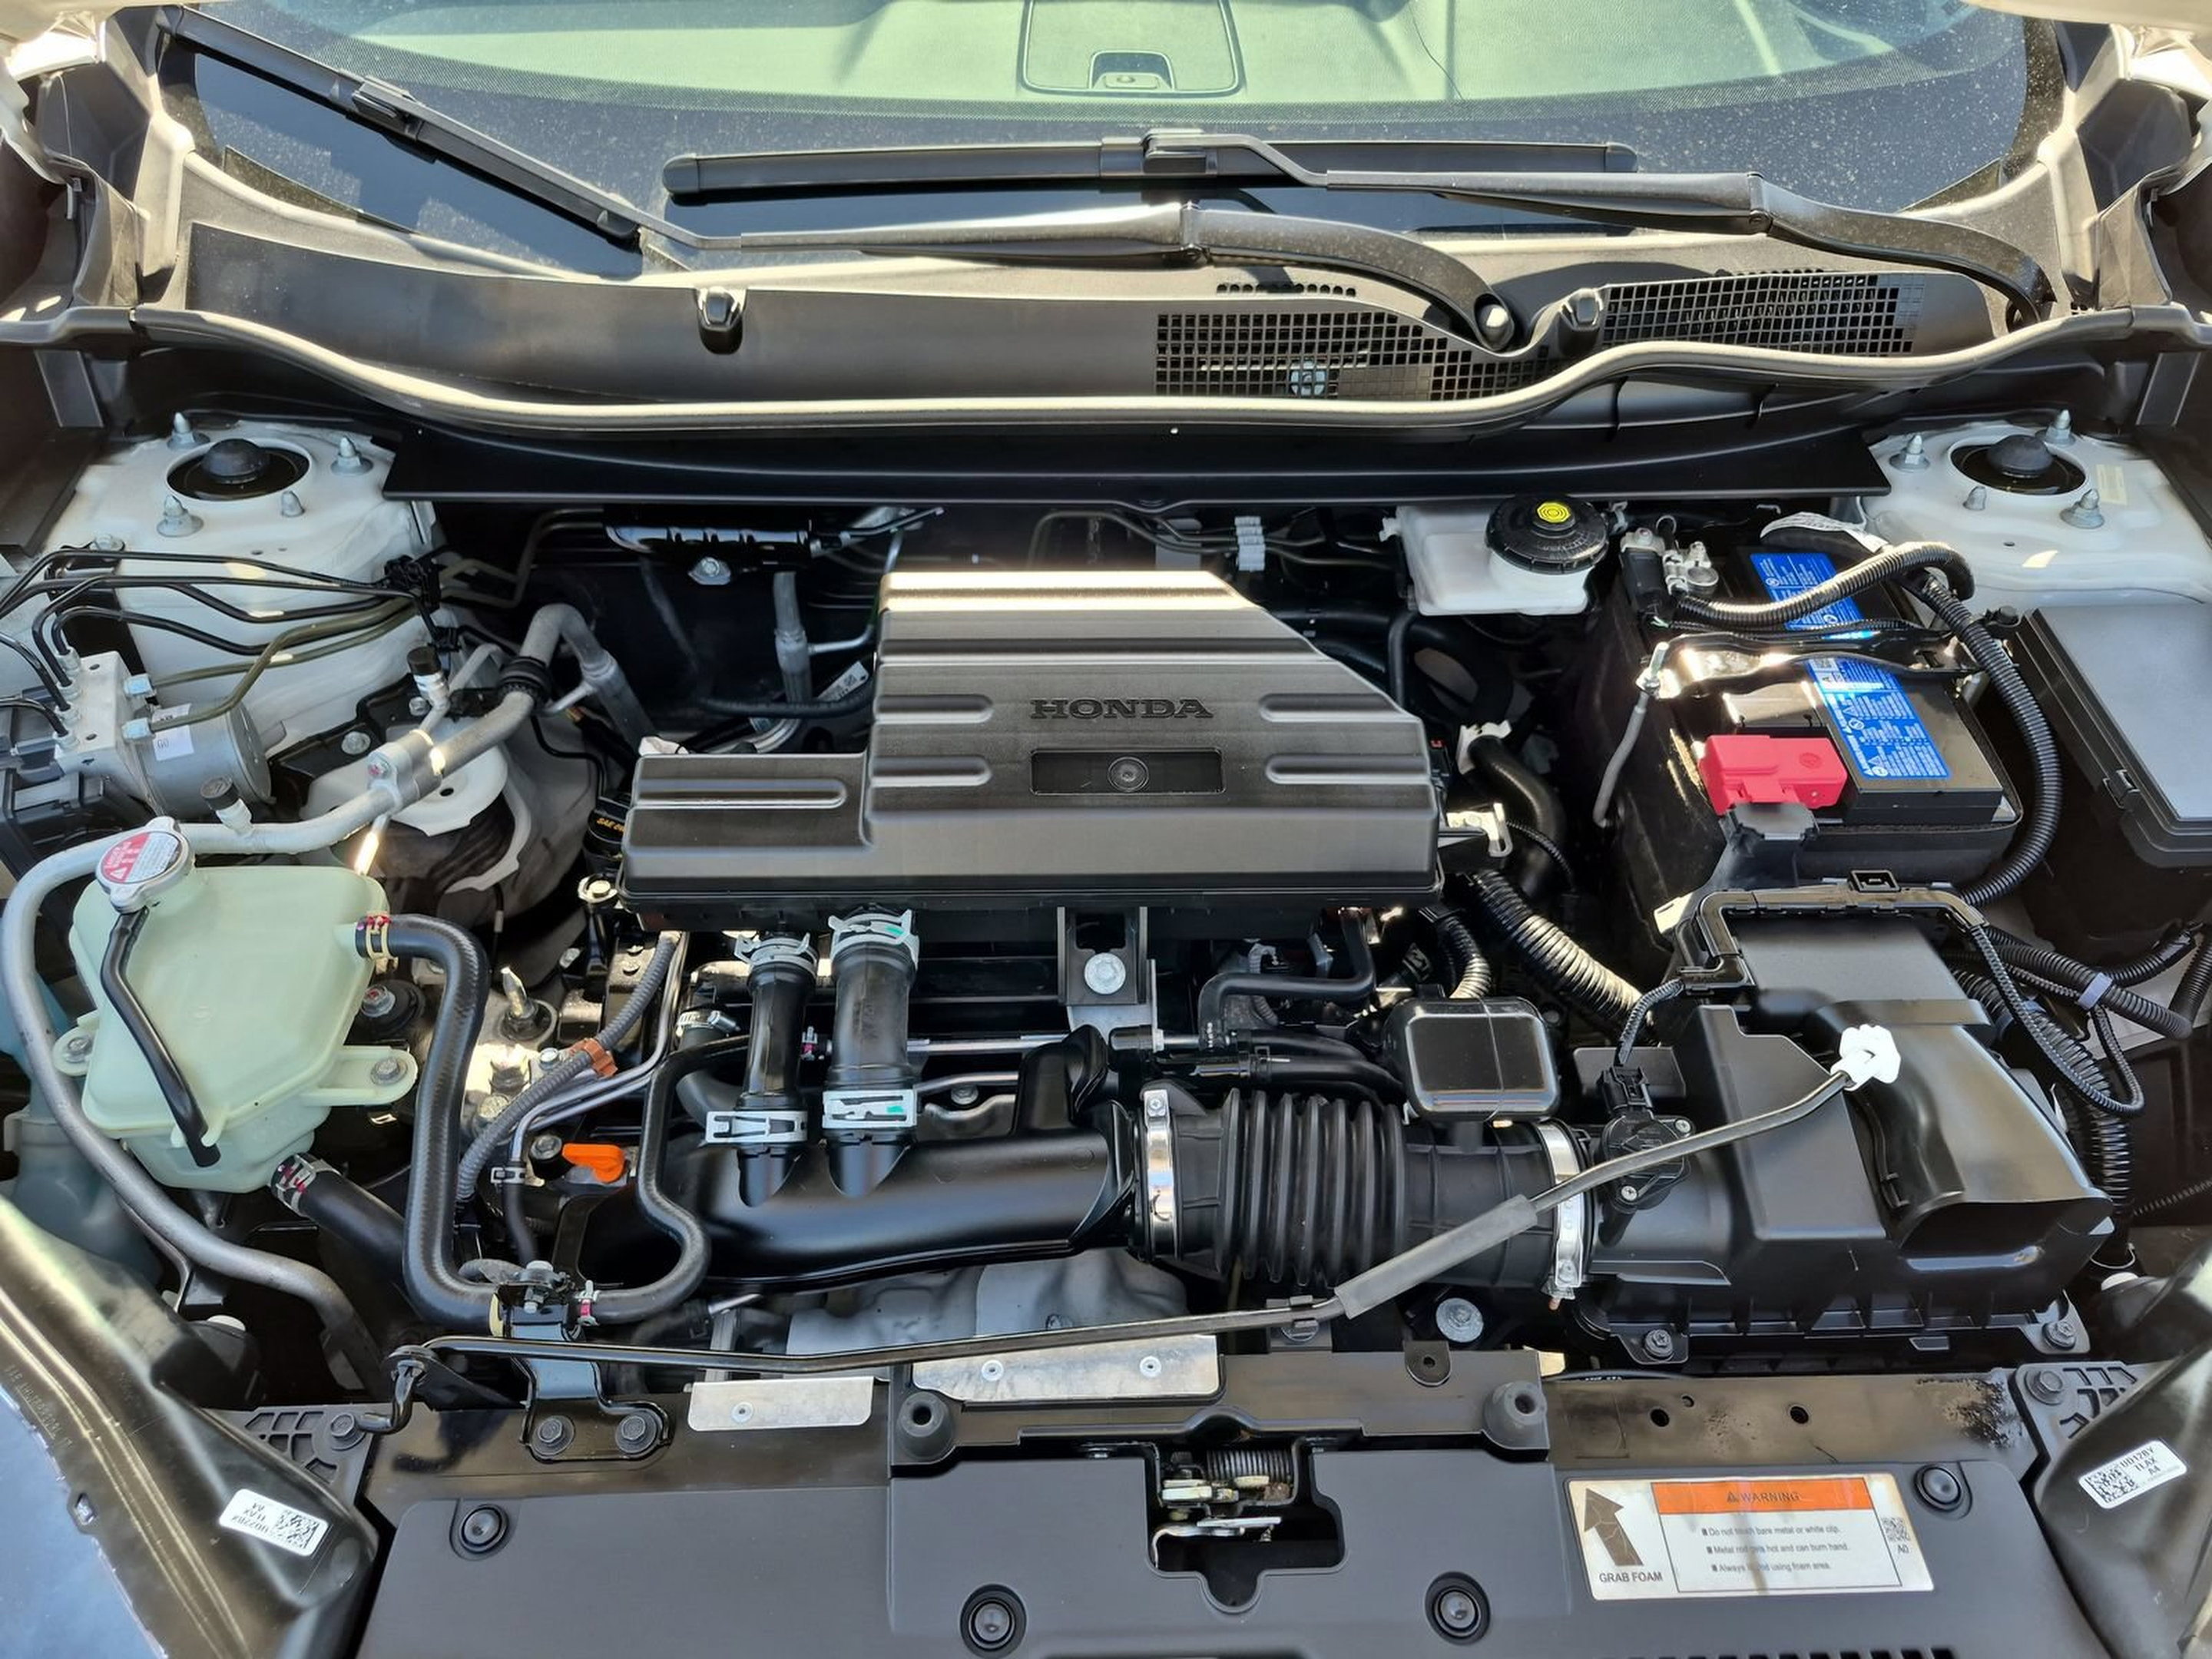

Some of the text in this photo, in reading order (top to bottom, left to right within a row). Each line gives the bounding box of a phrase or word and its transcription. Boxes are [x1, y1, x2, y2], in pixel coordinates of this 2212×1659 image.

[1031, 698, 1214, 720] HONDA
[1740, 1492, 1800, 1503] WARNING
[1709, 1527, 1720, 1536] Do
[1721, 1527, 1734, 1535] not
[1756, 1526, 1773, 1535] bare
[1774, 1525, 1794, 1535] metal
[1805, 1525, 1824, 1534] white
[1714, 1545, 1734, 1554] Metal
[1766, 1545, 1779, 1553] hot
[1780, 1544, 1794, 1552] and
[1719, 1564, 1746, 1573] Always
[1598, 1571, 1664, 1584] GRAB FOAM
